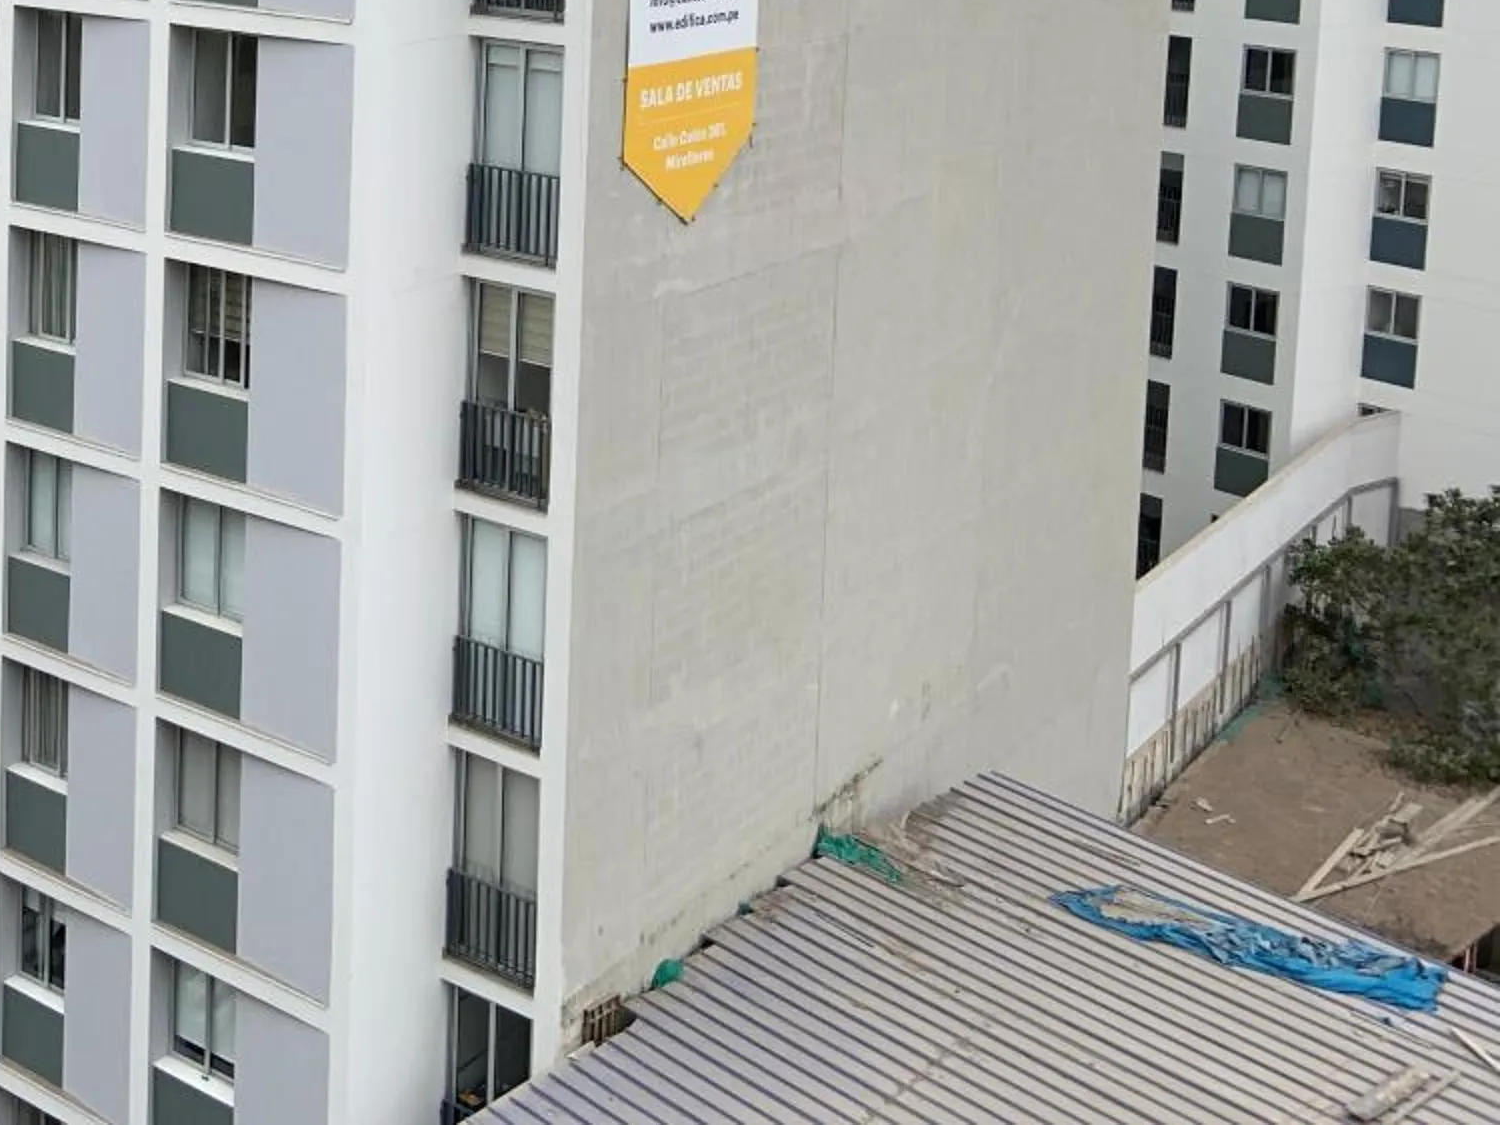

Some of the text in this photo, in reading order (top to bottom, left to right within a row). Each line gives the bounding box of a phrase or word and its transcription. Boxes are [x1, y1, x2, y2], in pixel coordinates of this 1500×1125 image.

[650, 10, 739, 33] www.edifica.com.pe
[640, 71, 743, 109] SALA DE VENTAS
